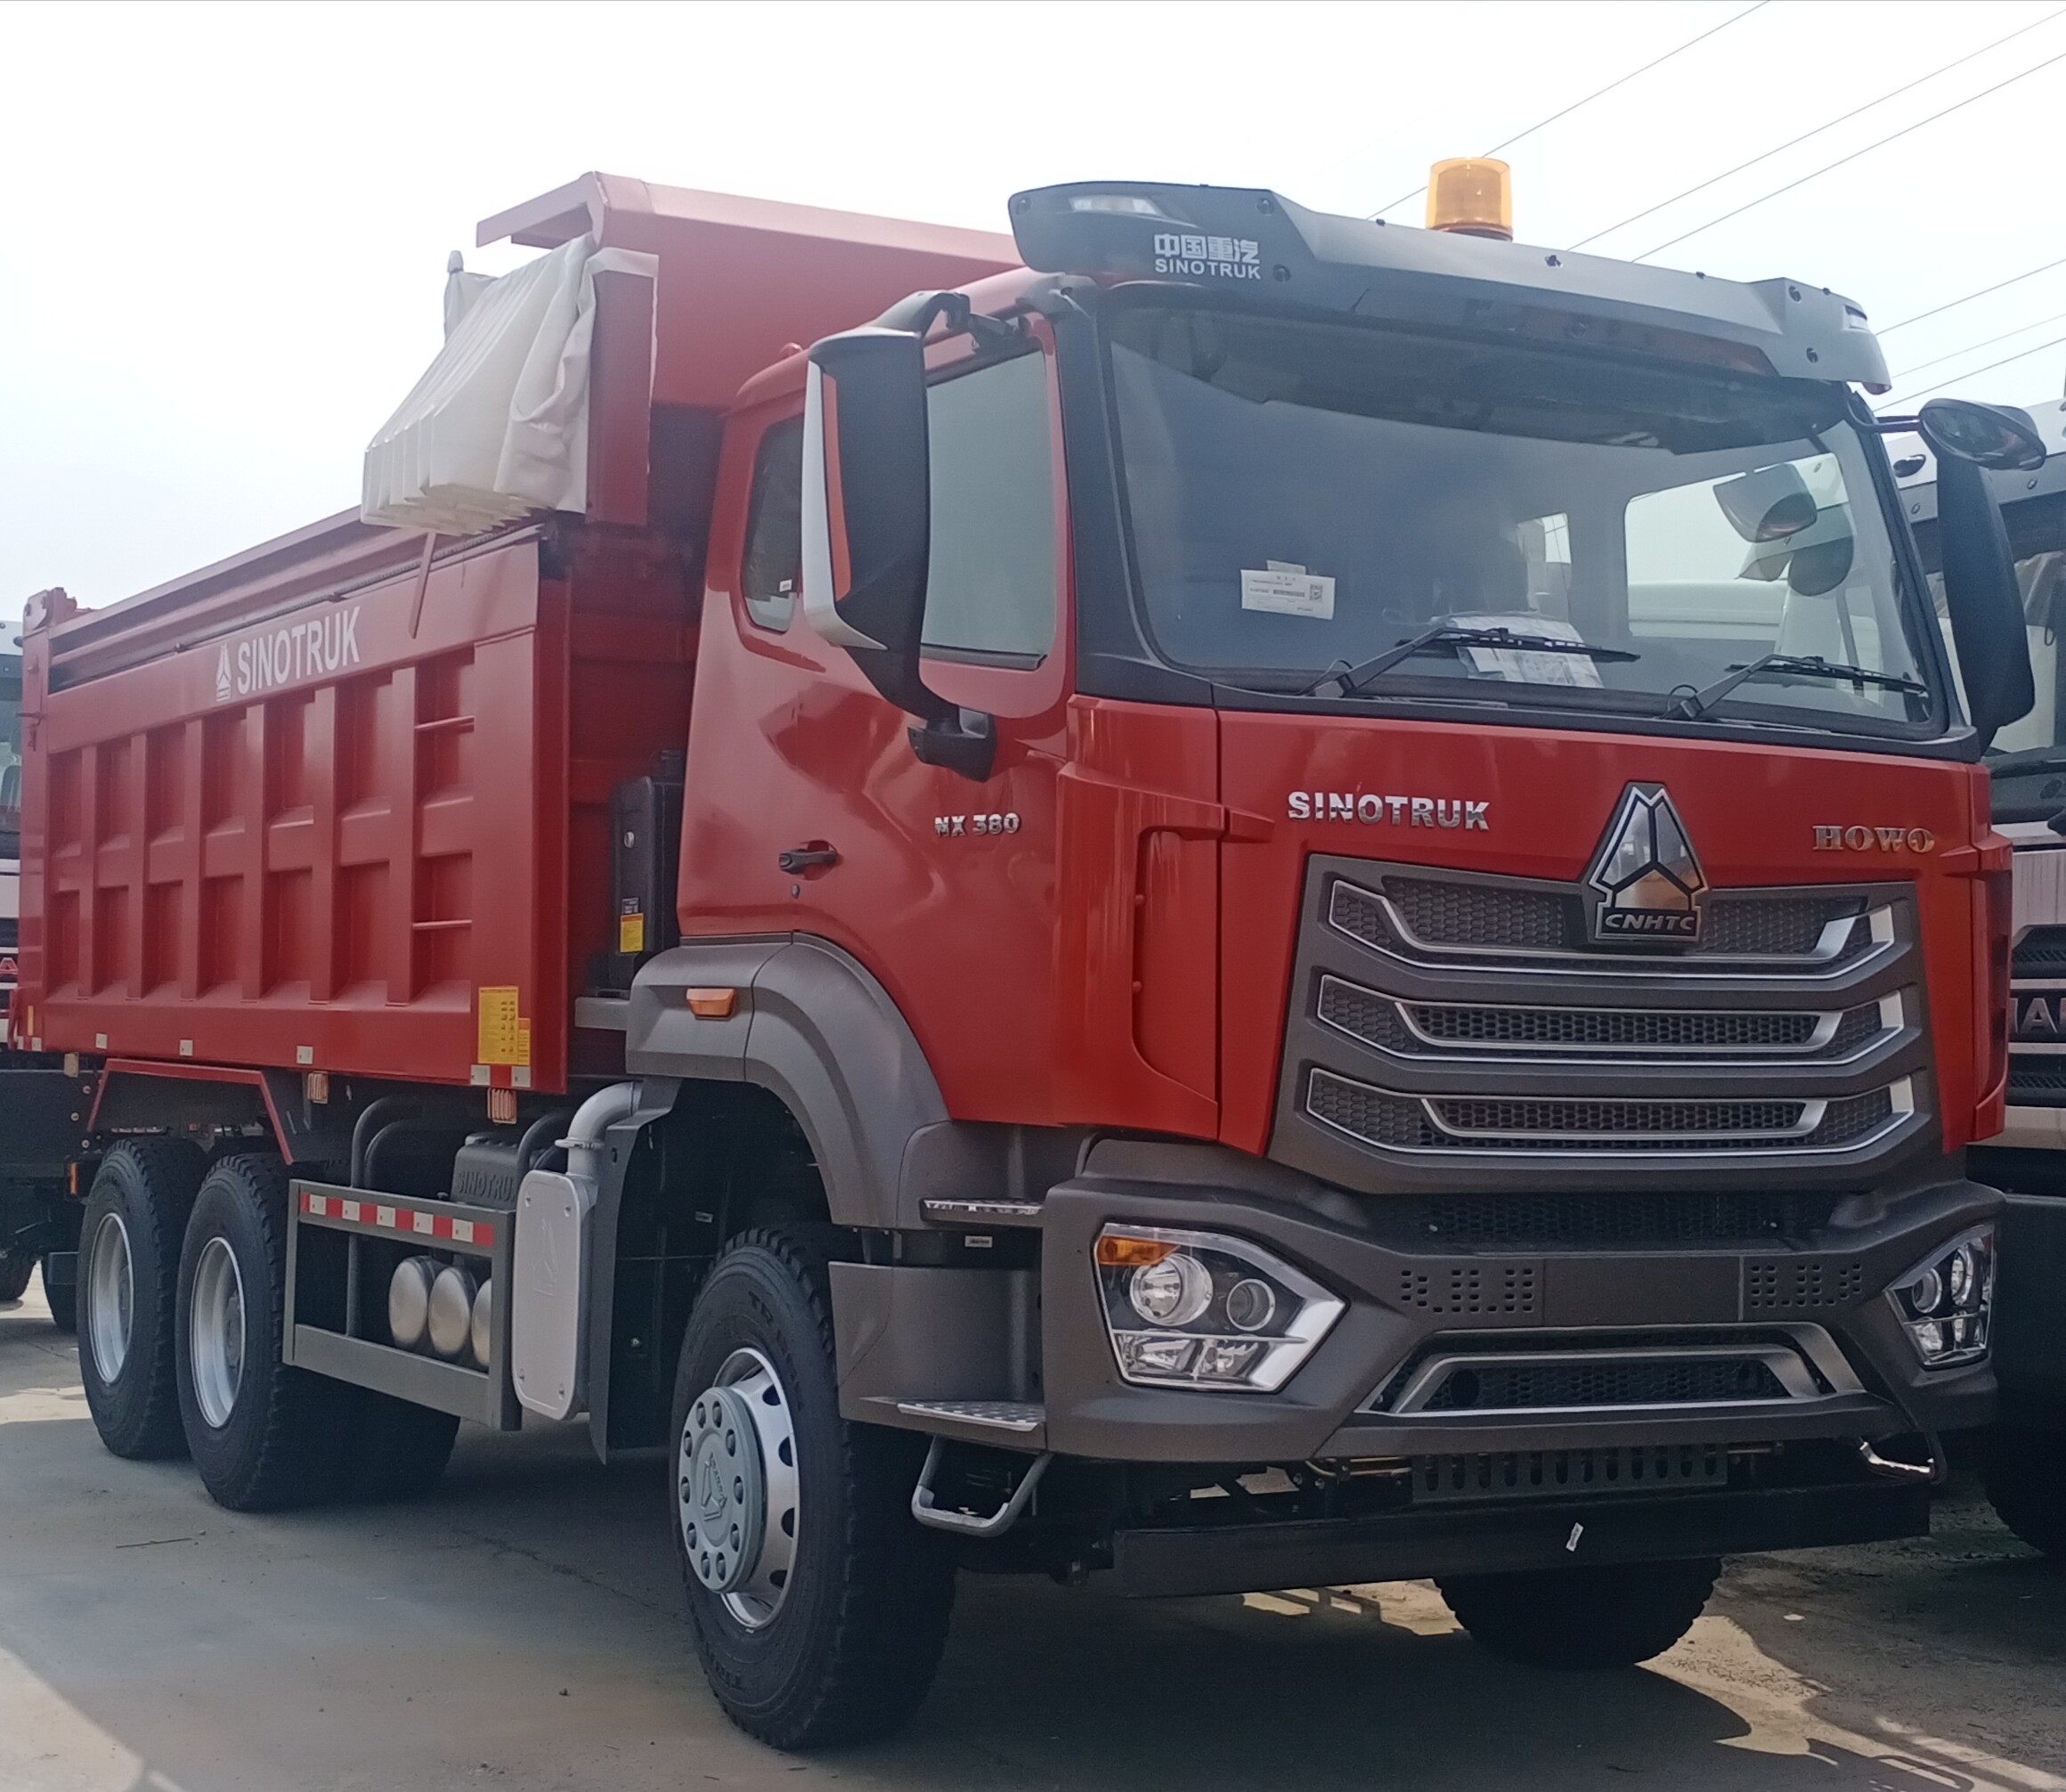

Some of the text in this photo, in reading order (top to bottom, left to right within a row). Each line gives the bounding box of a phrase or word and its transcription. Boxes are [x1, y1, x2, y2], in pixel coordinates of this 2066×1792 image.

[1154, 233, 1260, 264] 中国重汽
[1155, 258, 1261, 280] SINOTRUK
[238, 606, 360, 695] SINOTRUK
[1288, 791, 1490, 830] SINOTRUK
[935, 816, 966, 837] NX
[1812, 825, 1935, 852] HOWO
[1605, 914, 1695, 930] CNHTC
